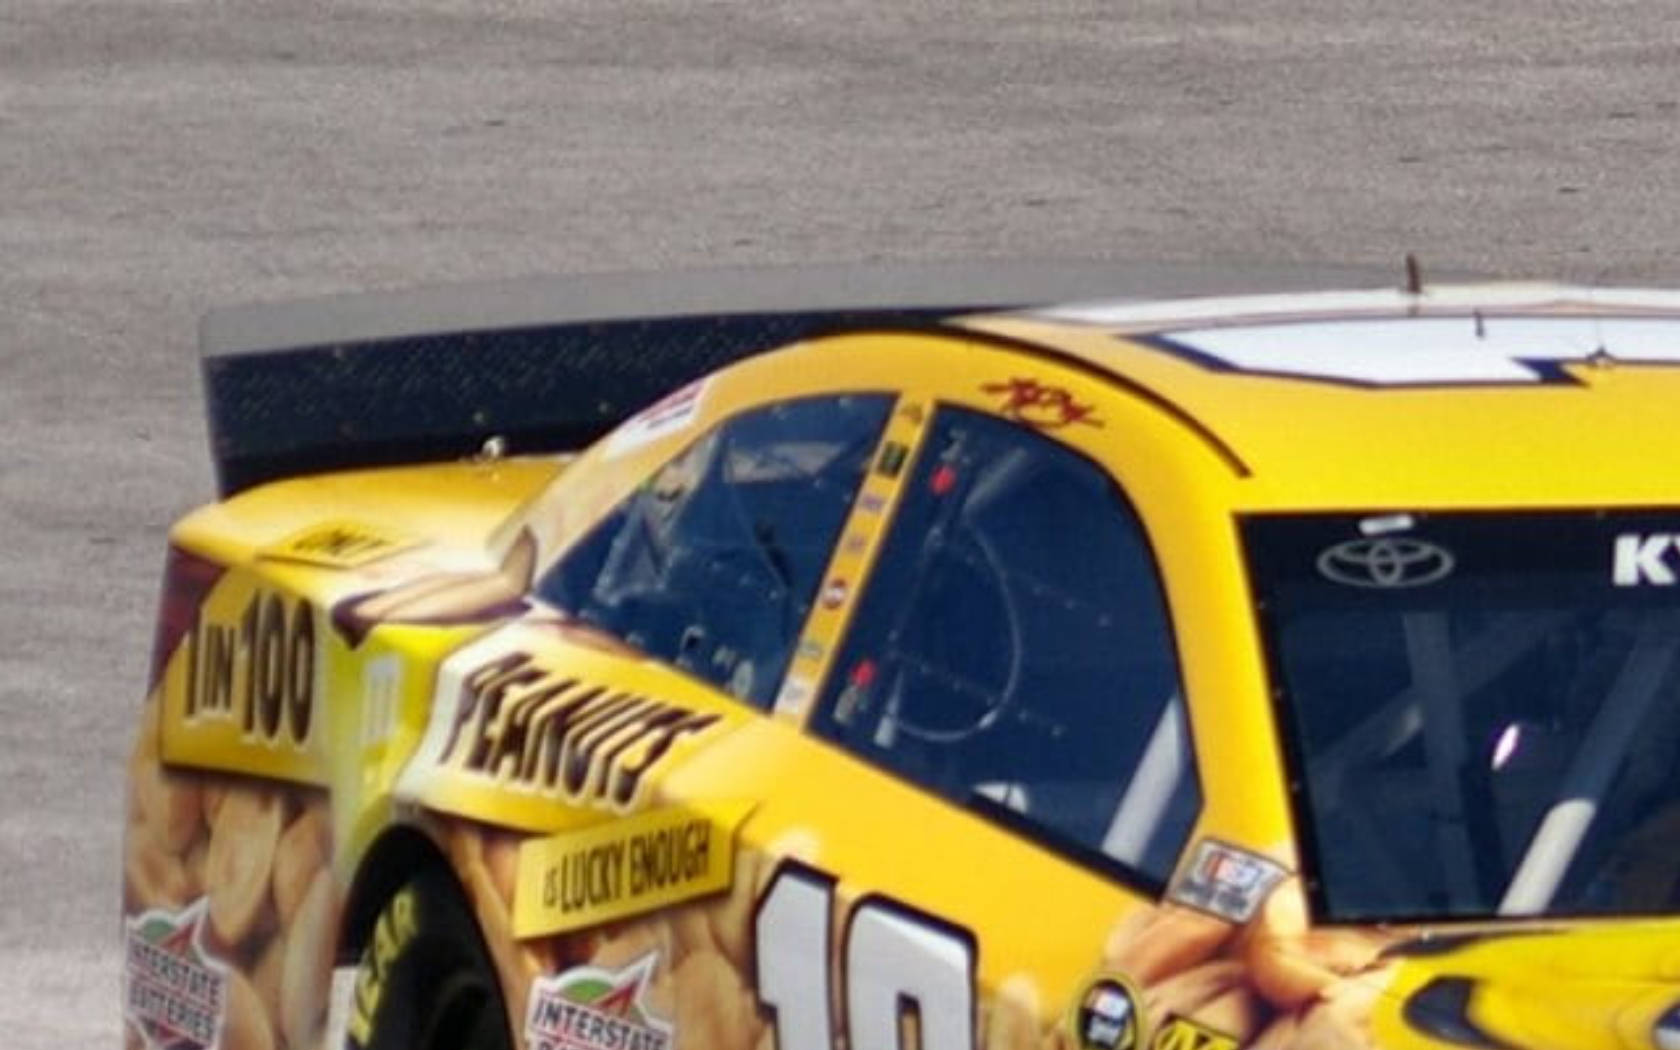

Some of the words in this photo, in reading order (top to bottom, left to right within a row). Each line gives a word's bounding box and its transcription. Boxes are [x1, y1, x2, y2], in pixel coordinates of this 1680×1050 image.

[203, 622, 236, 712] IN
[242, 586, 316, 744] 100
[438, 650, 726, 806] PEANUTS
[560, 838, 626, 914] LUCKY
[628, 816, 712, 898] ENOUGH
